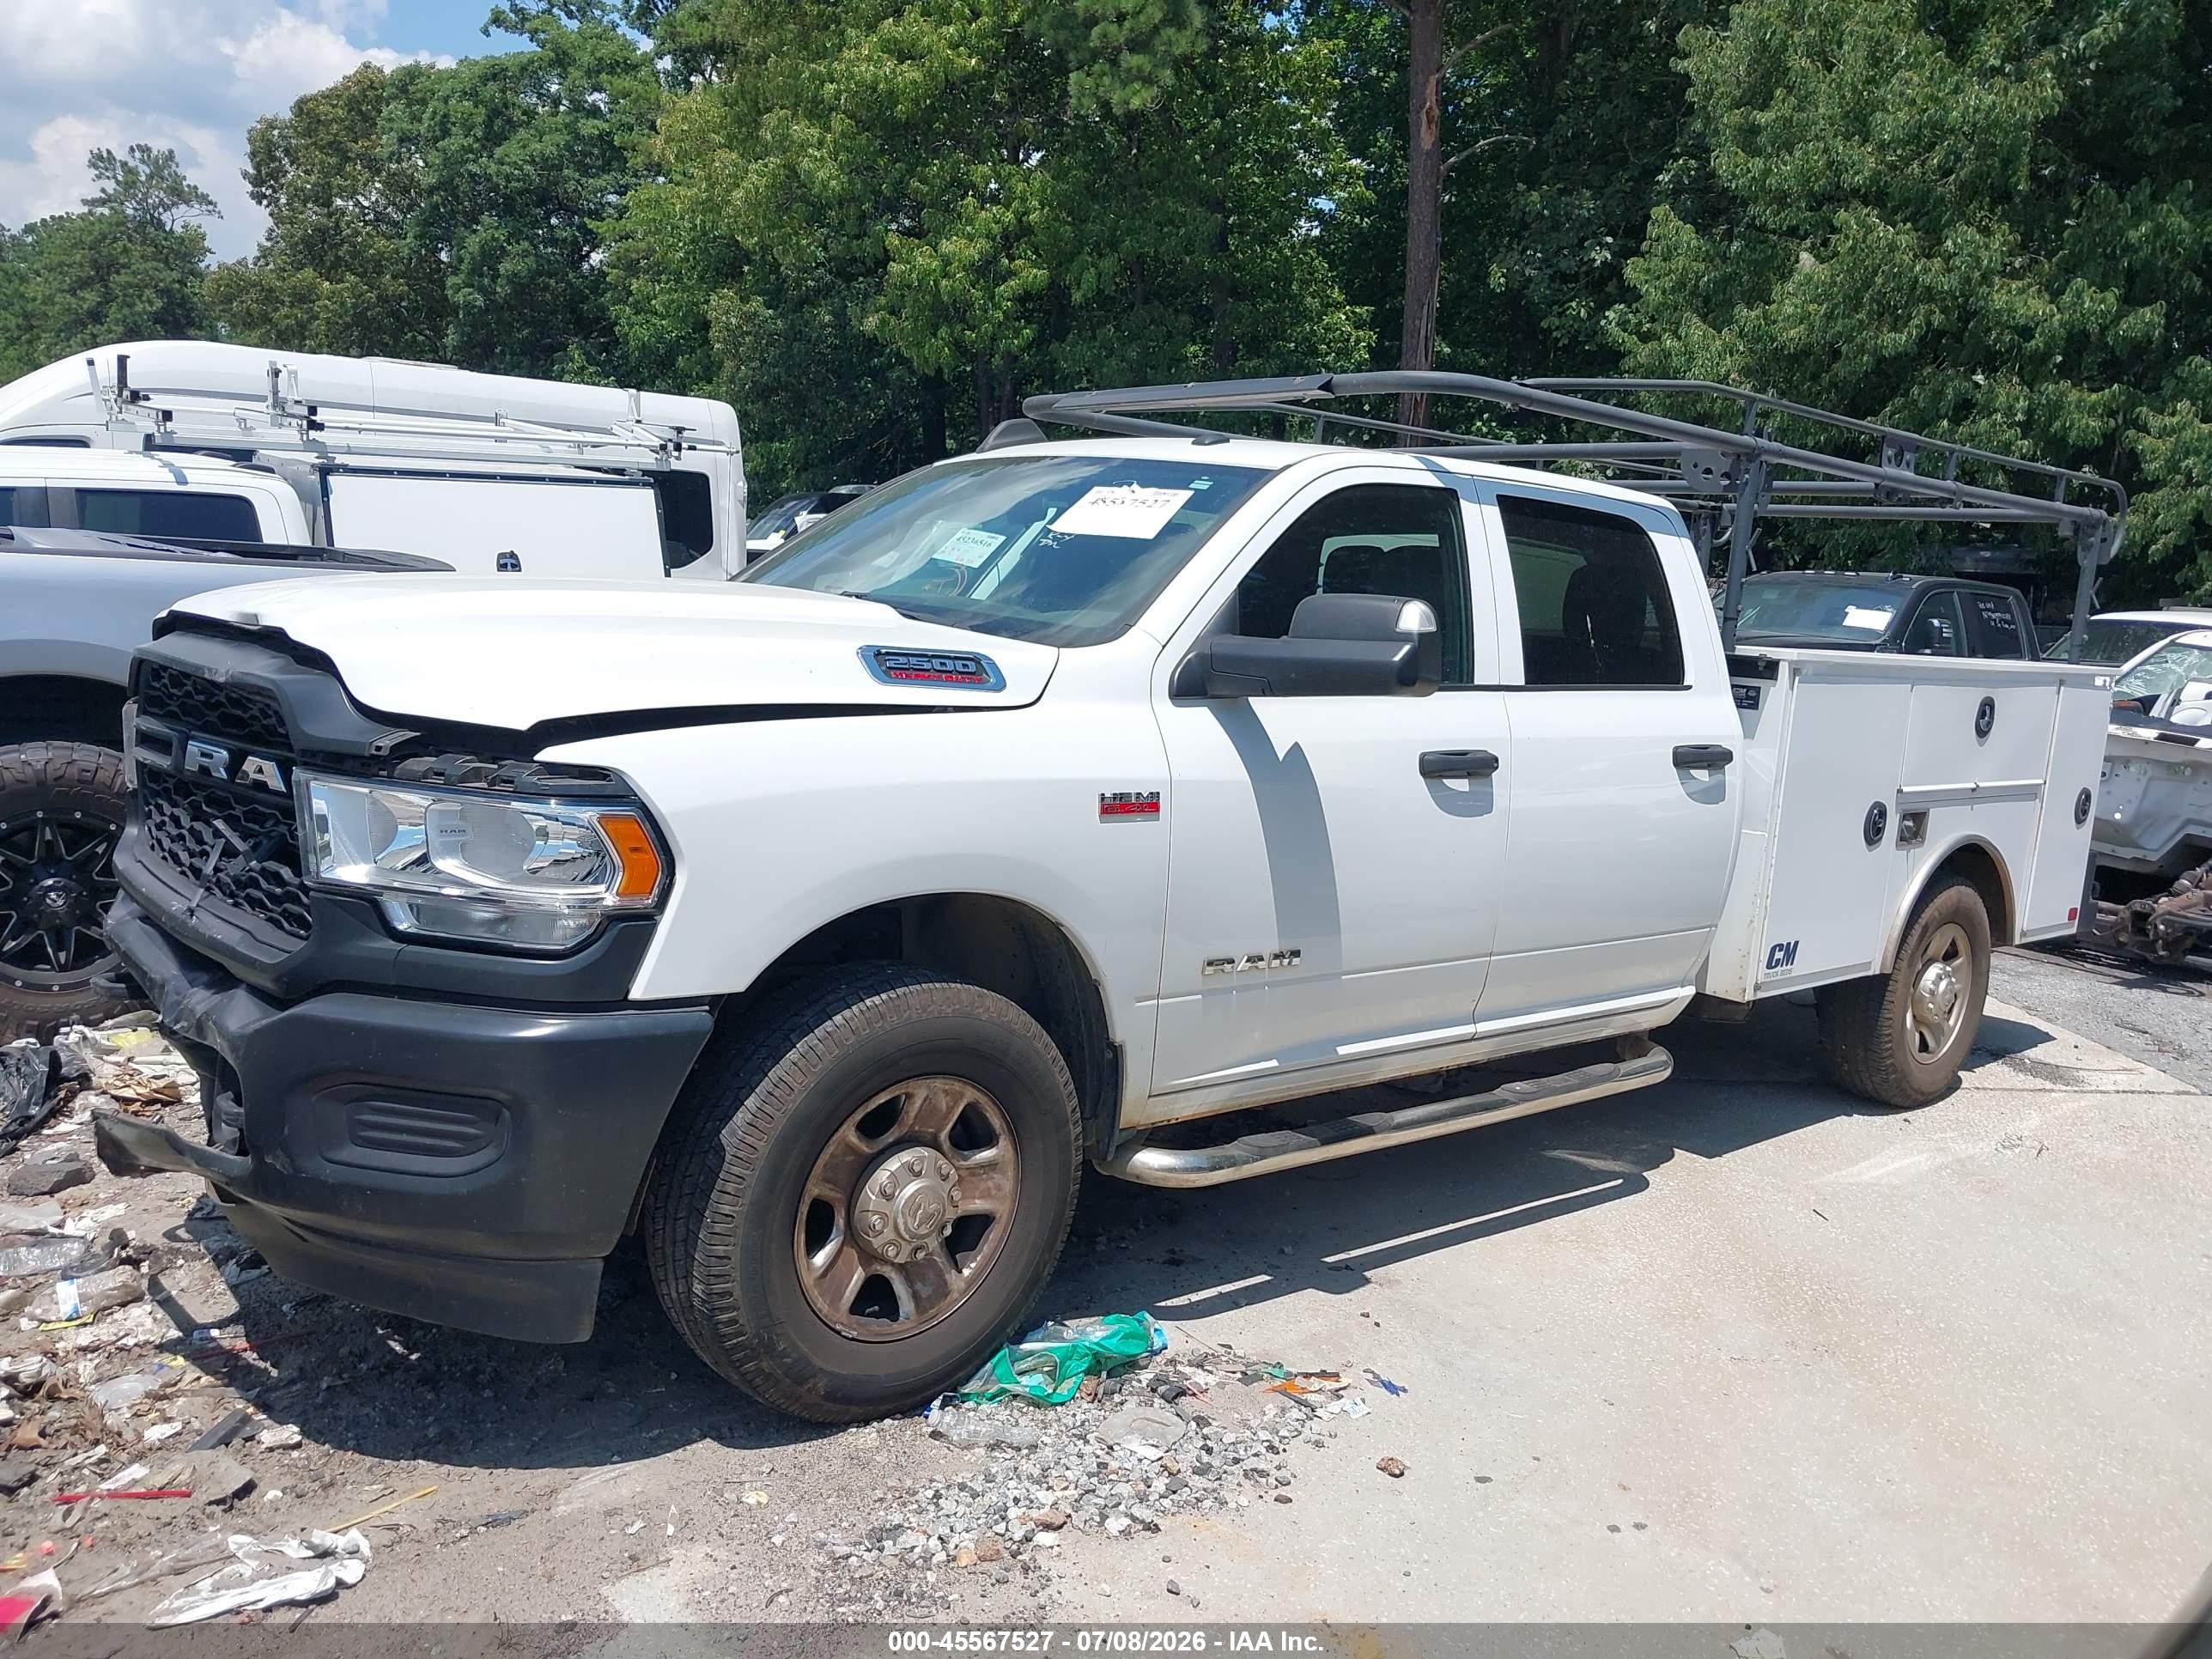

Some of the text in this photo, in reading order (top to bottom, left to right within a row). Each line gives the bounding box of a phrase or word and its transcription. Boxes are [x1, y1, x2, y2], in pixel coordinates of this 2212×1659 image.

[884, 655, 977, 674] 2500
[185, 740, 287, 793] RA
[1100, 791, 1160, 804] HEMI
[1202, 949, 1302, 975] RAM
[1765, 939, 1800, 970] CM
